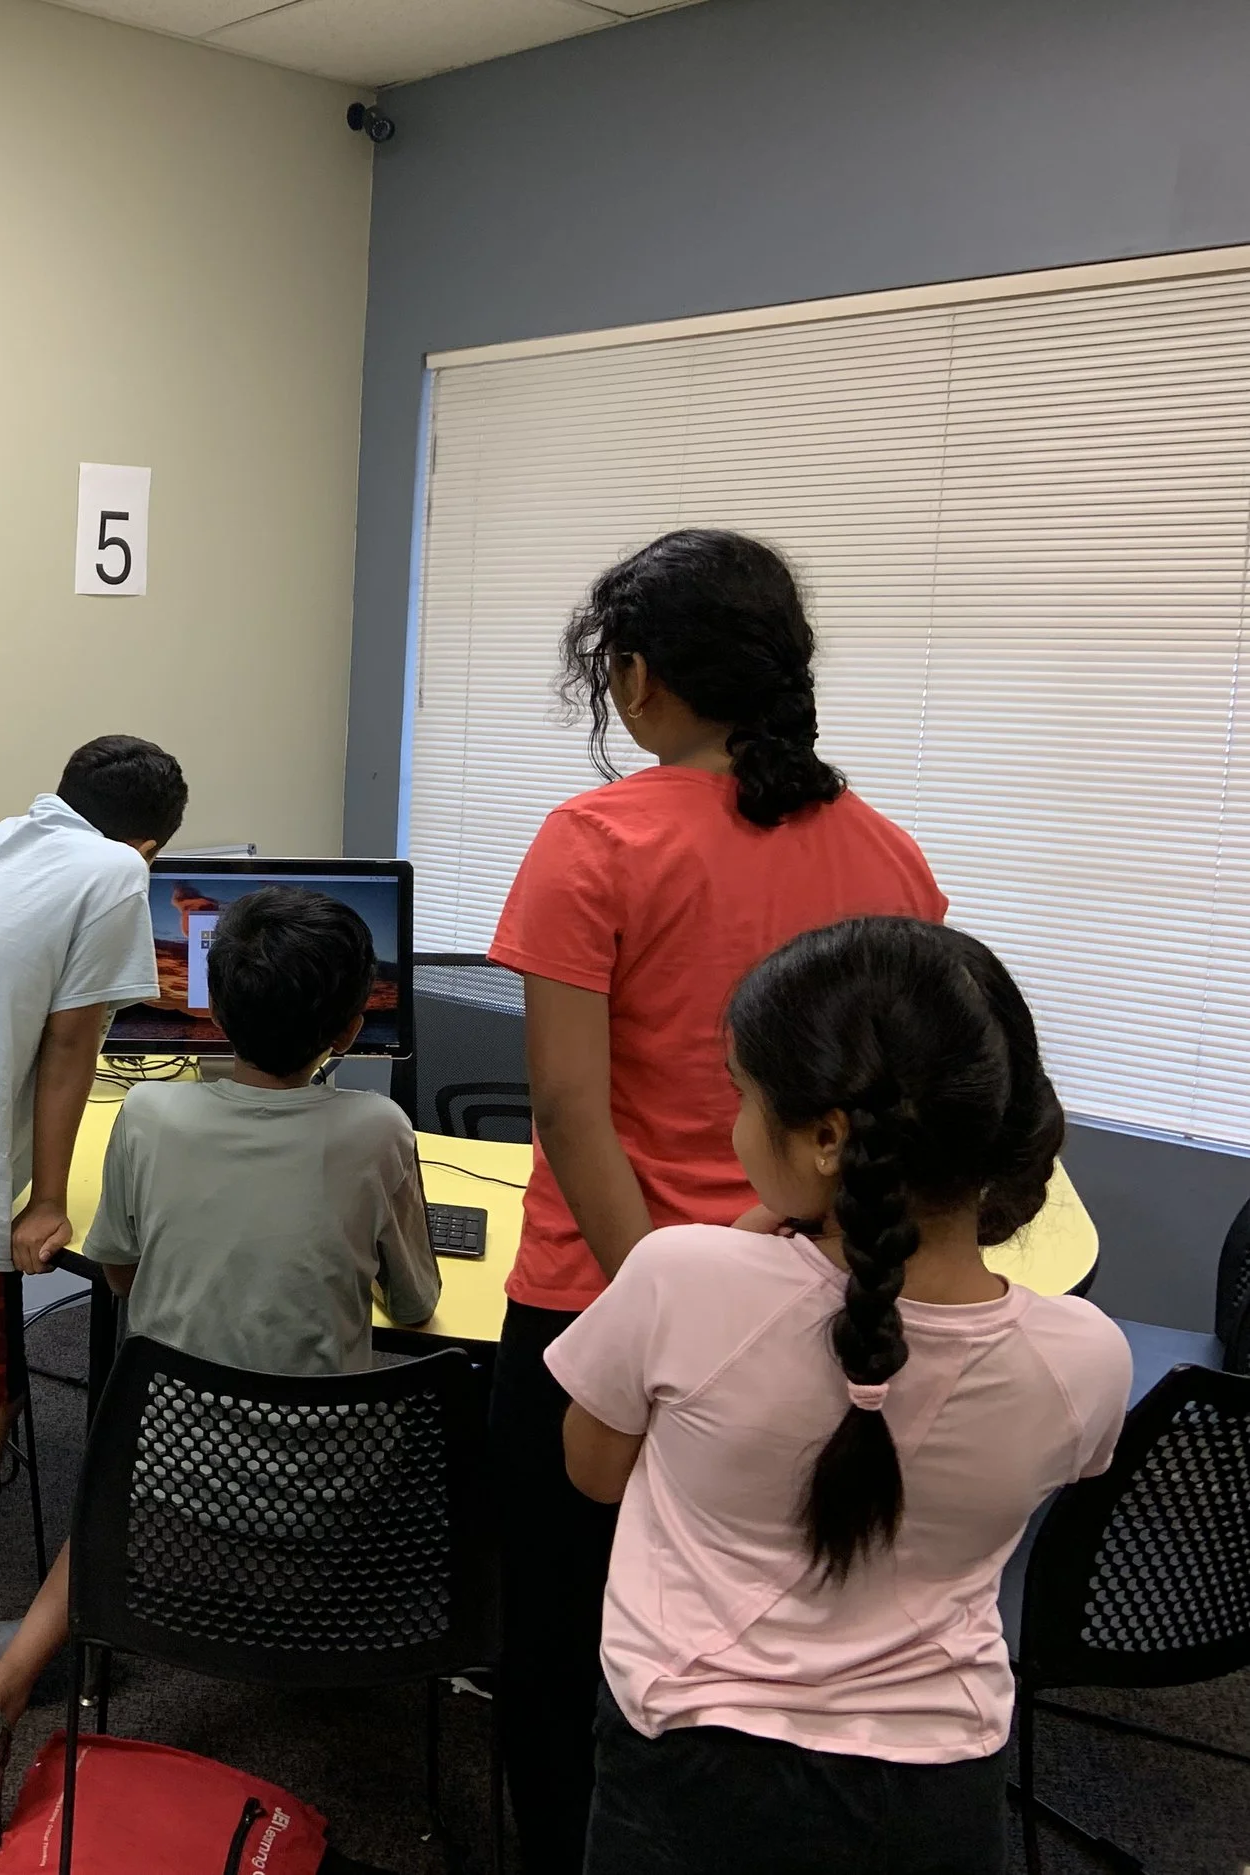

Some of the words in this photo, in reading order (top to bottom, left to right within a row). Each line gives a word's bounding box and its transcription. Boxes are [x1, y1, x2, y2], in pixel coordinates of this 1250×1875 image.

[95, 510, 132, 585] 5
[271, 1806, 291, 1829] JEI
[251, 1825, 282, 1869] Learnng
